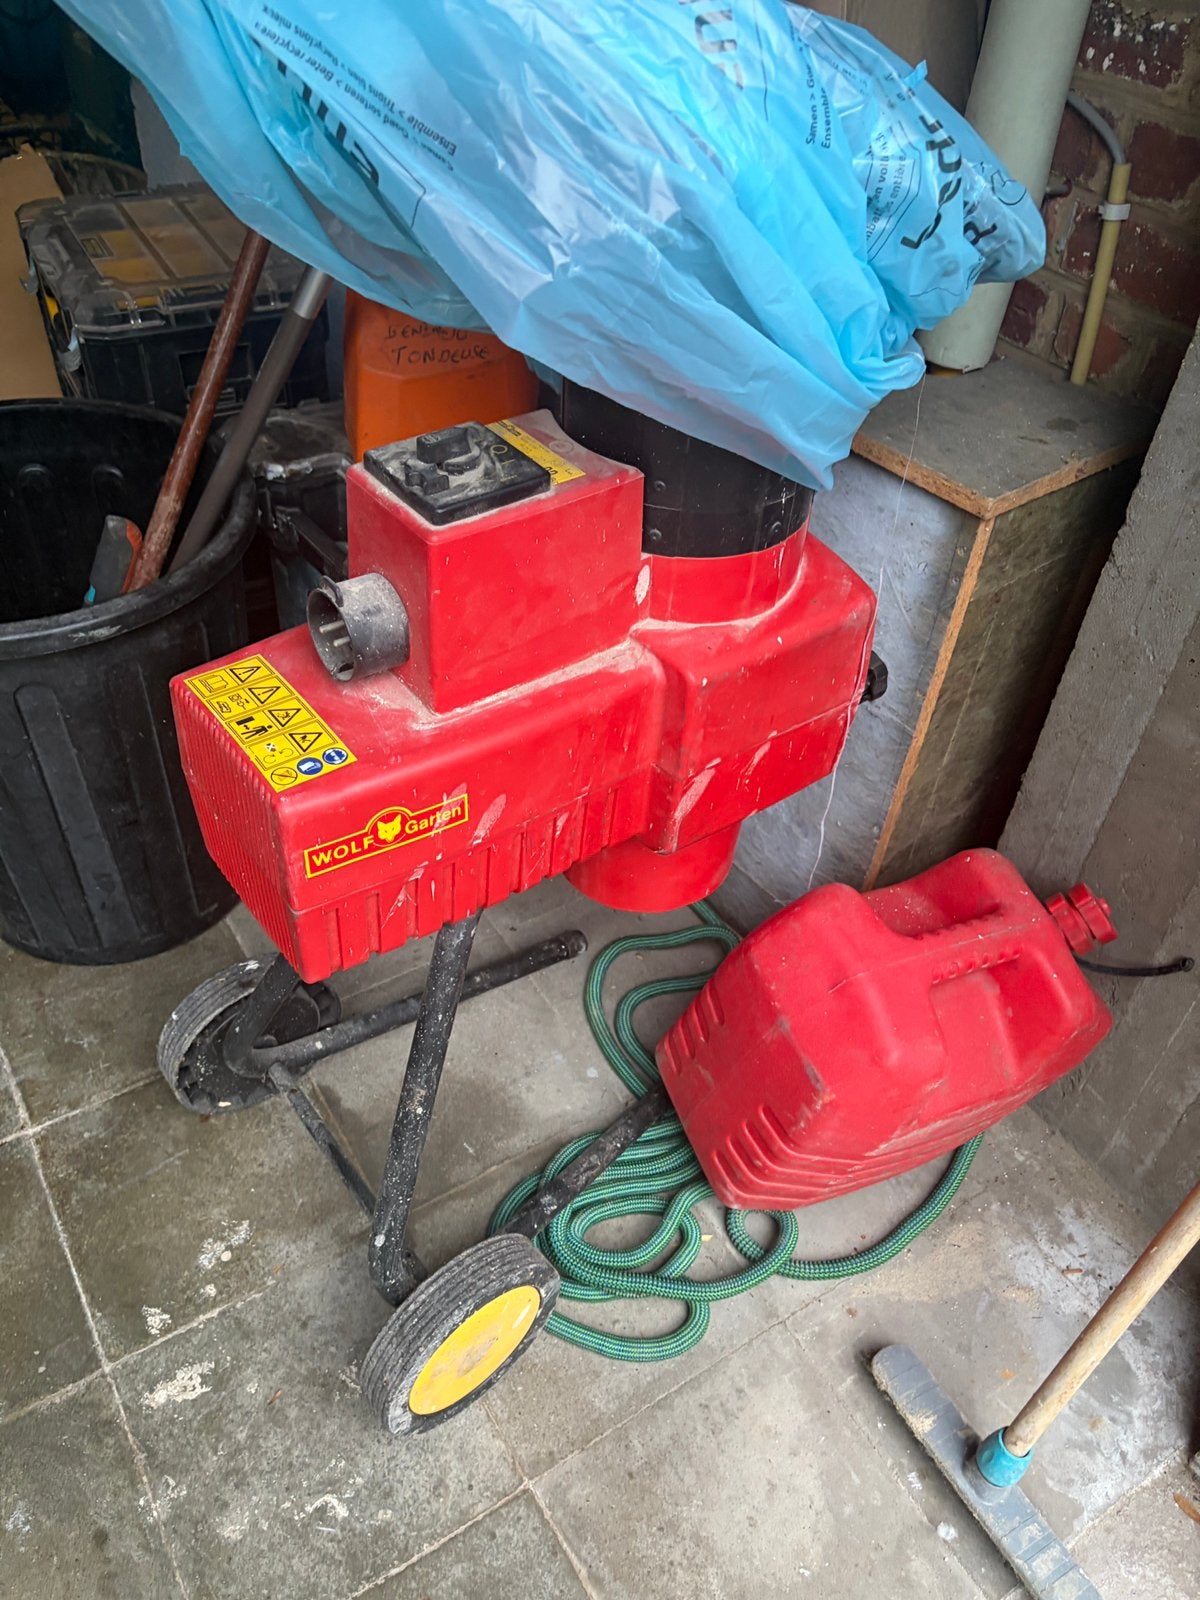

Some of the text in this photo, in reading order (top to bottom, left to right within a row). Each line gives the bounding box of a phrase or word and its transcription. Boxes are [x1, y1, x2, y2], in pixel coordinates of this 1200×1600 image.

[305, 56, 335, 82] Beter
[369, 84, 396, 114] Trions
[407, 114, 457, 157] Ensemble
[805, 104, 819, 145] Samen
[391, 344, 489, 366] TONDEUSE
[311, 806, 461, 867] WOLF Garten
